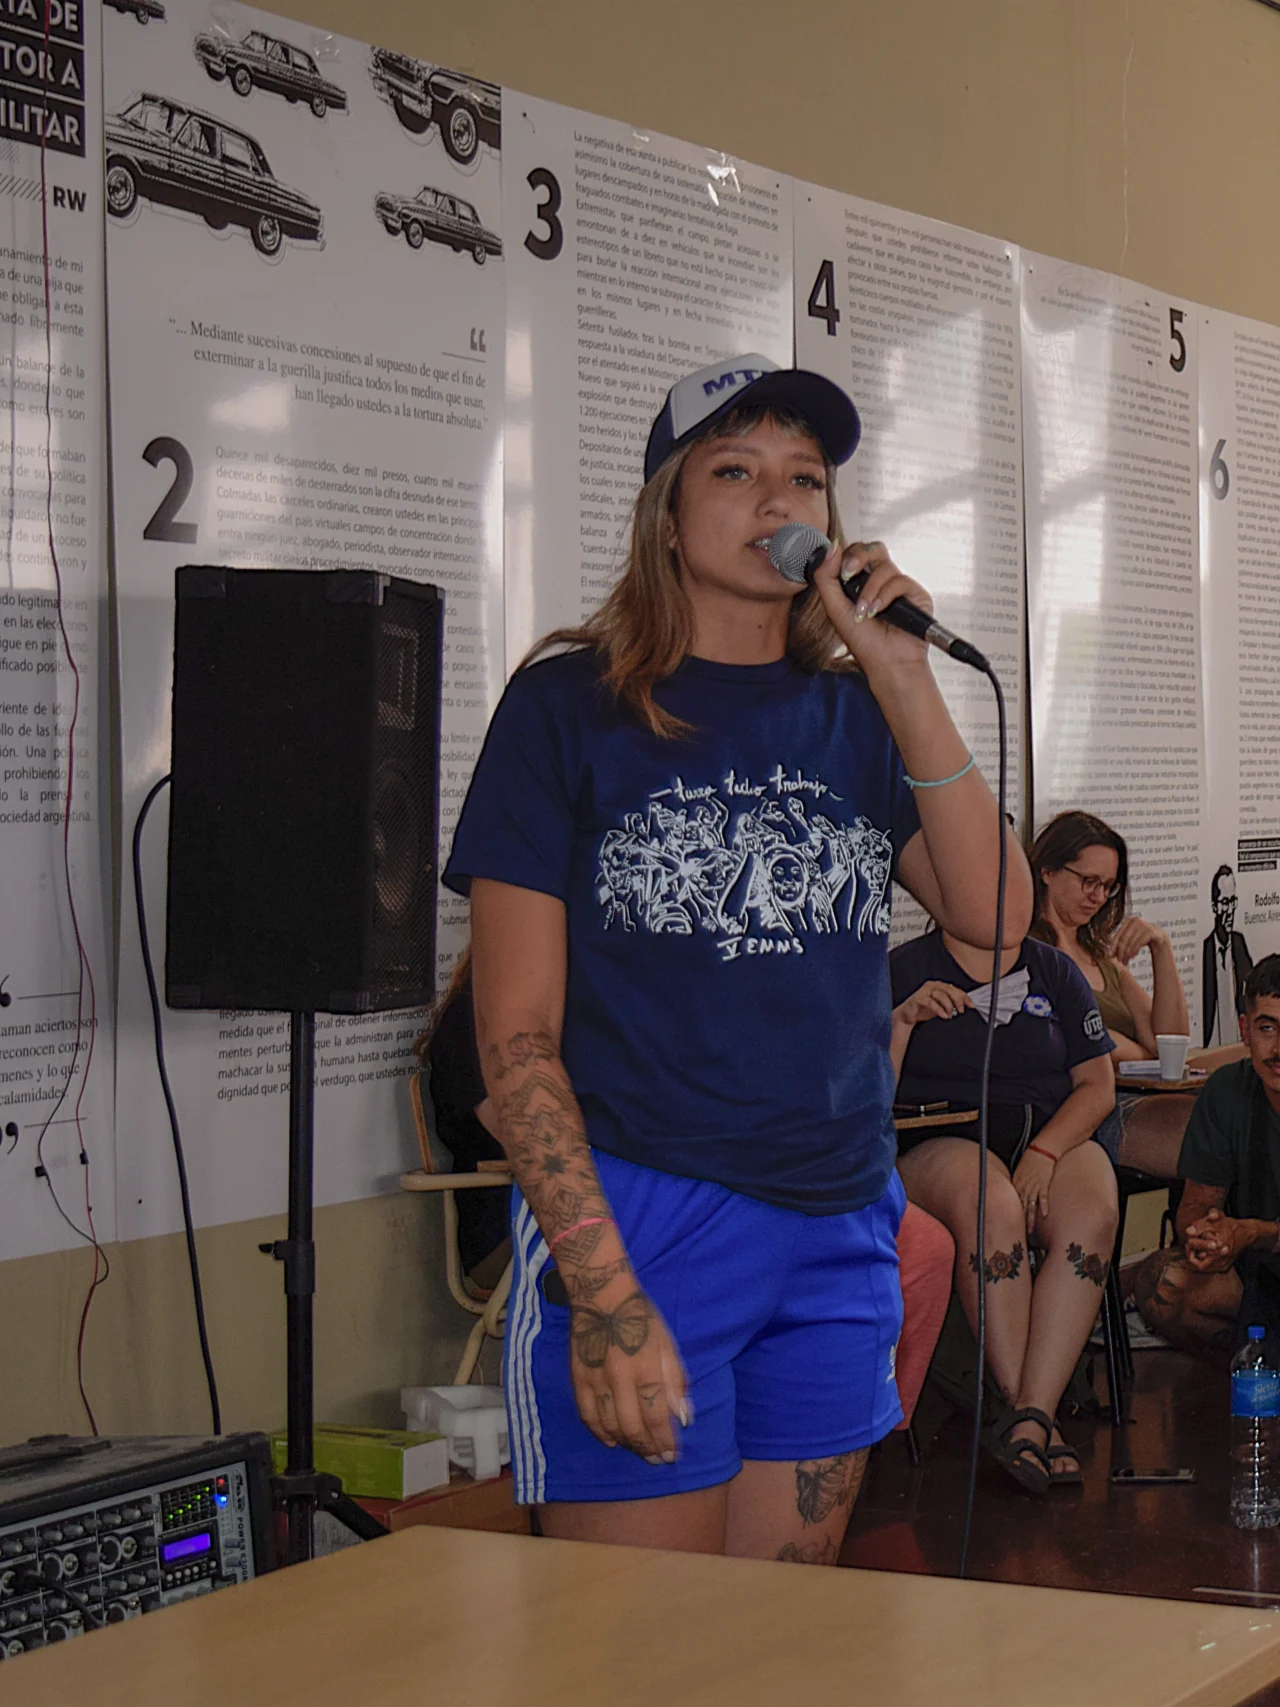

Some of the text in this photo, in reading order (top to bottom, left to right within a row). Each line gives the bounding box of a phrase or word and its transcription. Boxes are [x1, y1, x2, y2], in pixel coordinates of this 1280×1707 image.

[48, 0, 78, 32] DE
[61, 59, 80, 89] A
[53, 186, 87, 212] RW
[523, 167, 564, 261] 3
[55, 256, 68, 269] de
[71, 262, 83, 273] mi
[8, 269, 83, 294] de una que
[807, 259, 841, 337] 4
[1168, 307, 1188, 373] 5
[191, 321, 244, 344] Mediante
[247, 334, 298, 354] sucesivas
[300, 342, 362, 366] concesiones
[365, 353, 373, 366] al
[376, 359, 417, 374] supuesto
[420, 364, 431, 377] de
[433, 370, 449, 383] que
[452, 371, 460, 383] el
[462, 371, 473, 386] fin
[476, 375, 486, 388] de
[60, 364, 84, 378] de la
[194, 349, 486, 410] exterminar a la guerilla justifica todos los medios que usan,
[702, 370, 763, 396] MT
[66, 389, 85, 401] que
[295, 385, 314, 401] han
[317, 388, 354, 408] llegado
[357, 397, 392, 414] ustedes
[395, 405, 400, 416] a
[403, 403, 411, 417] la
[414, 407, 444, 423] tortura
[68, 408, 85, 420] son
[216, 446, 453, 488] Quince mil desaparecidos, diez mil presos, cuatro mil
[1209, 438, 1231, 501] 6
[65, 493, 86, 505] para
[142, 436, 199, 545] 2
[216, 468, 459, 508] decenas de miles de desterrados son la cifra desnuda de ese
[4, 616, 34, 629] en las
[25, 638, 57, 654] en pie
[34, 703, 47, 716] de
[18, 723, 50, 737] de las
[26, 747, 46, 758] Una
[20, 788, 29, 801] la
[1255, 892, 1280, 906] Rodolfo
[35, 1018, 76, 1033] aciertos
[219, 1026, 254, 1040] medida
[257, 1025, 274, 1038] que
[277, 1022, 284, 1033] el
[336, 1017, 346, 1027] de
[348, 1014, 380, 1026] obtener
[219, 1029, 414, 1060] mentes la administran para
[37, 1068, 44, 1083] y
[47, 1064, 57, 1077] lo
[218, 1051, 379, 1079] machacar la humana hasta
[218, 1065, 406, 1102] dignidad que verdugo, que ustedes
